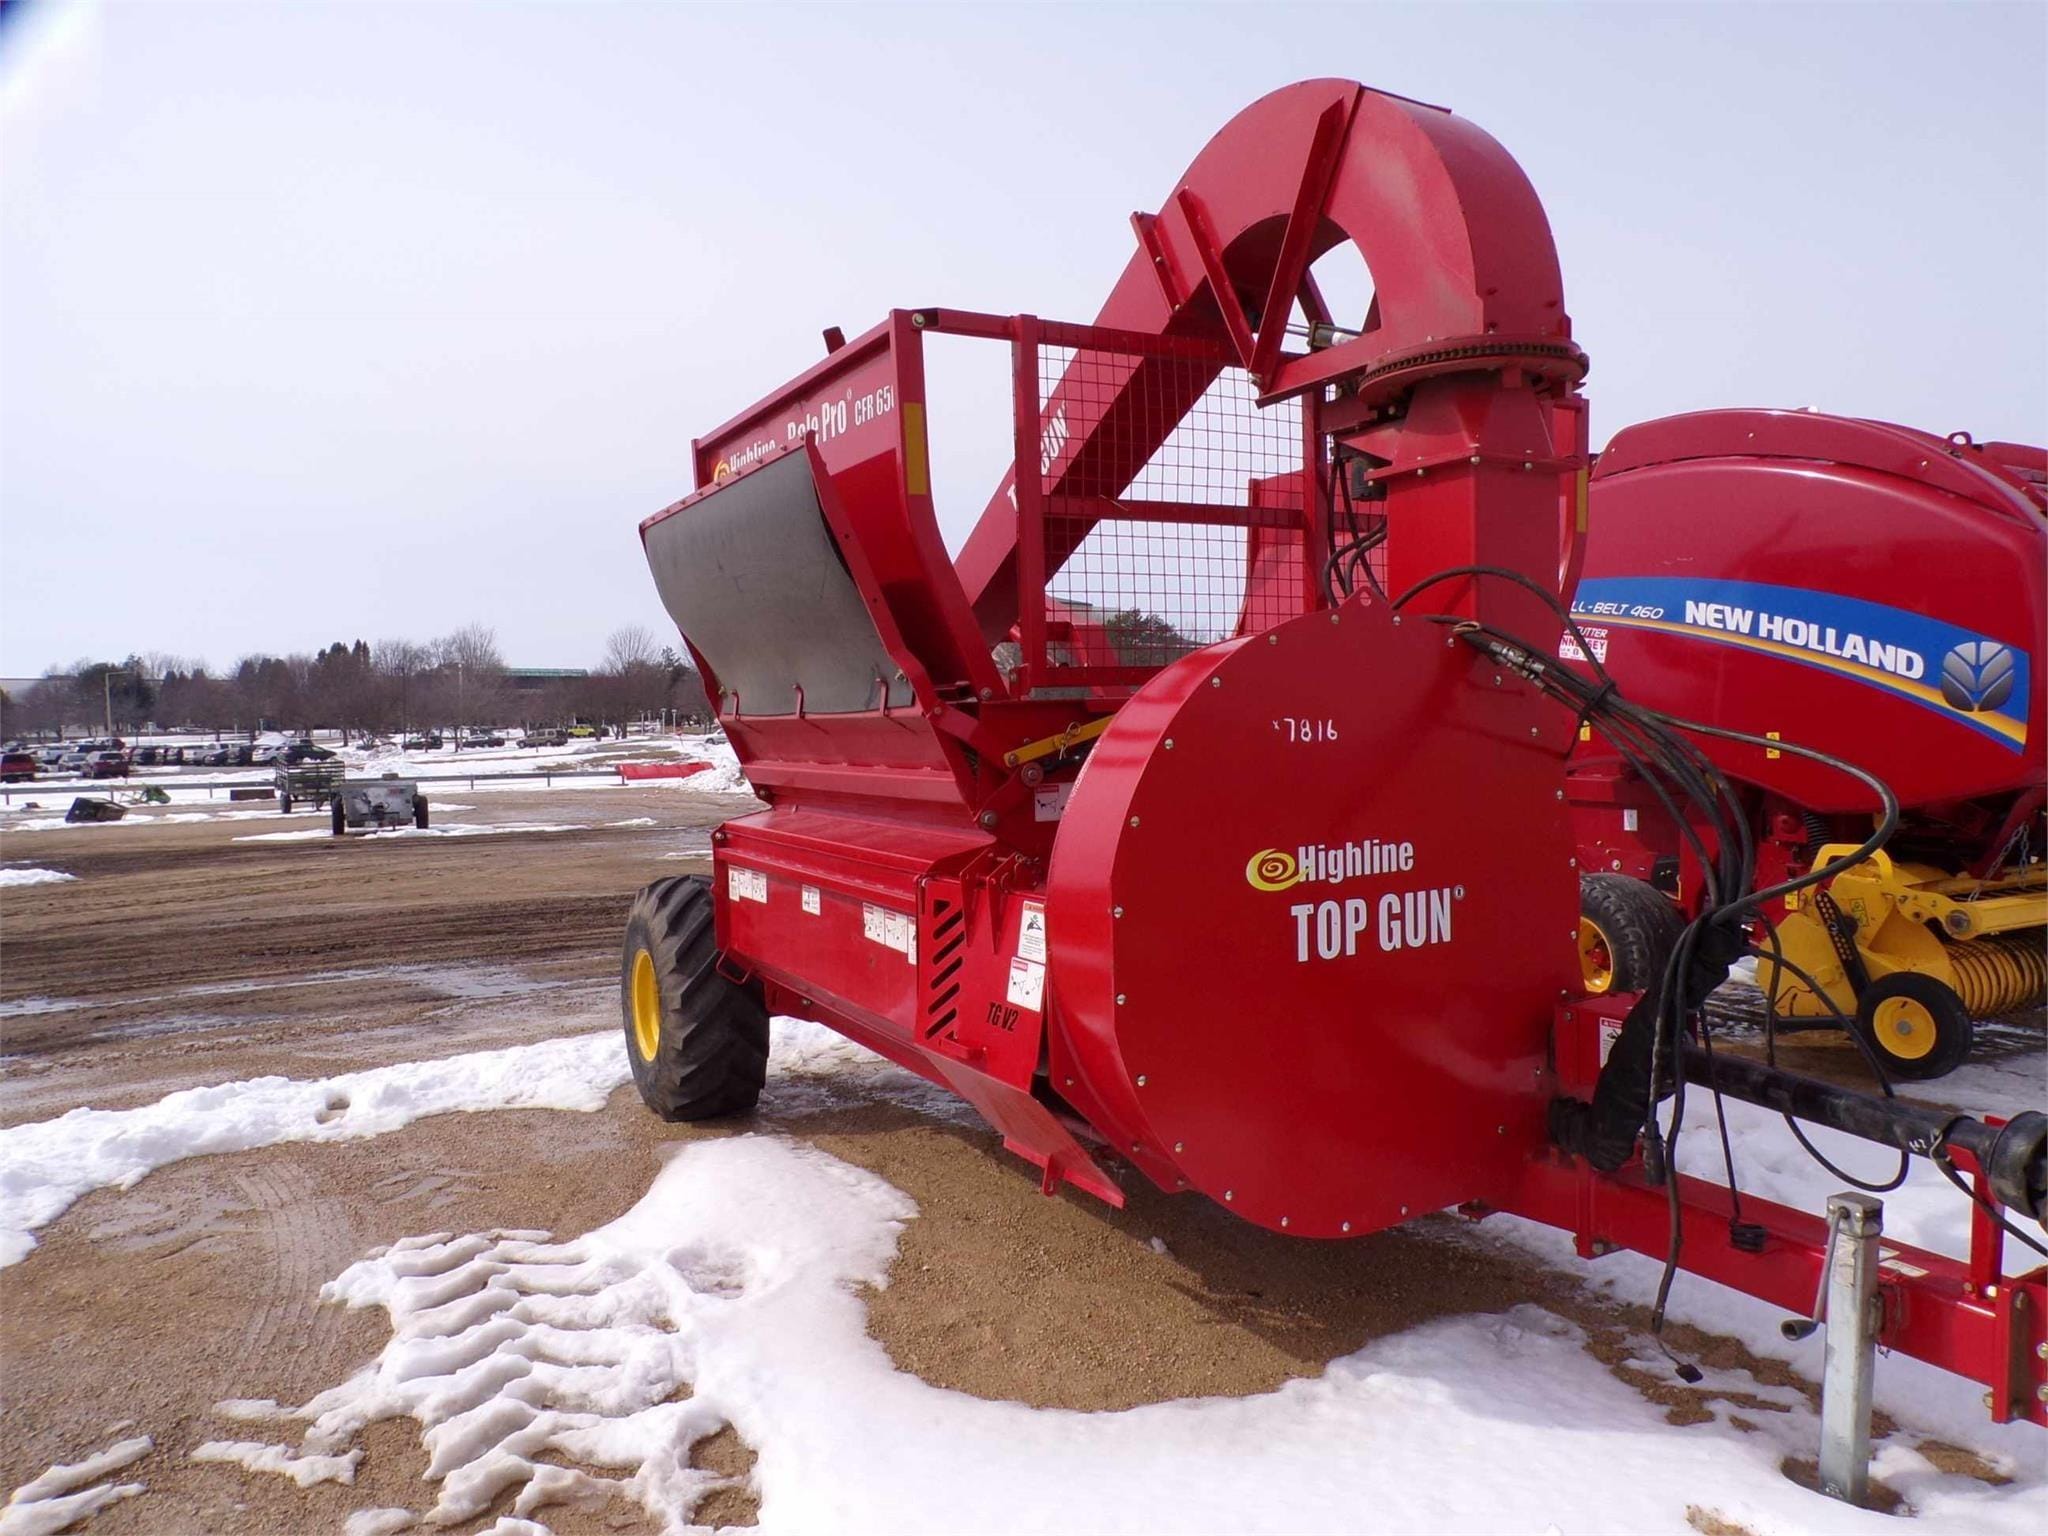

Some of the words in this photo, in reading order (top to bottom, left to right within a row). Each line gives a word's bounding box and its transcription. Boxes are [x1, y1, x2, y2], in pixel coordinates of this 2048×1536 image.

[822, 401, 847, 442] Pro
[854, 394, 874, 426] CFR
[876, 384, 895, 416] 65
[1630, 606, 1664, 620] 460
[1685, 600, 1753, 634] NEW
[1758, 612, 1924, 680] HOLLAND
[1298, 839, 1414, 884] Highline
[1291, 899, 1367, 962] TOP
[1378, 887, 1451, 952] GUN
[986, 1002, 1001, 1026] TG
[1002, 1005, 1019, 1031] V2
